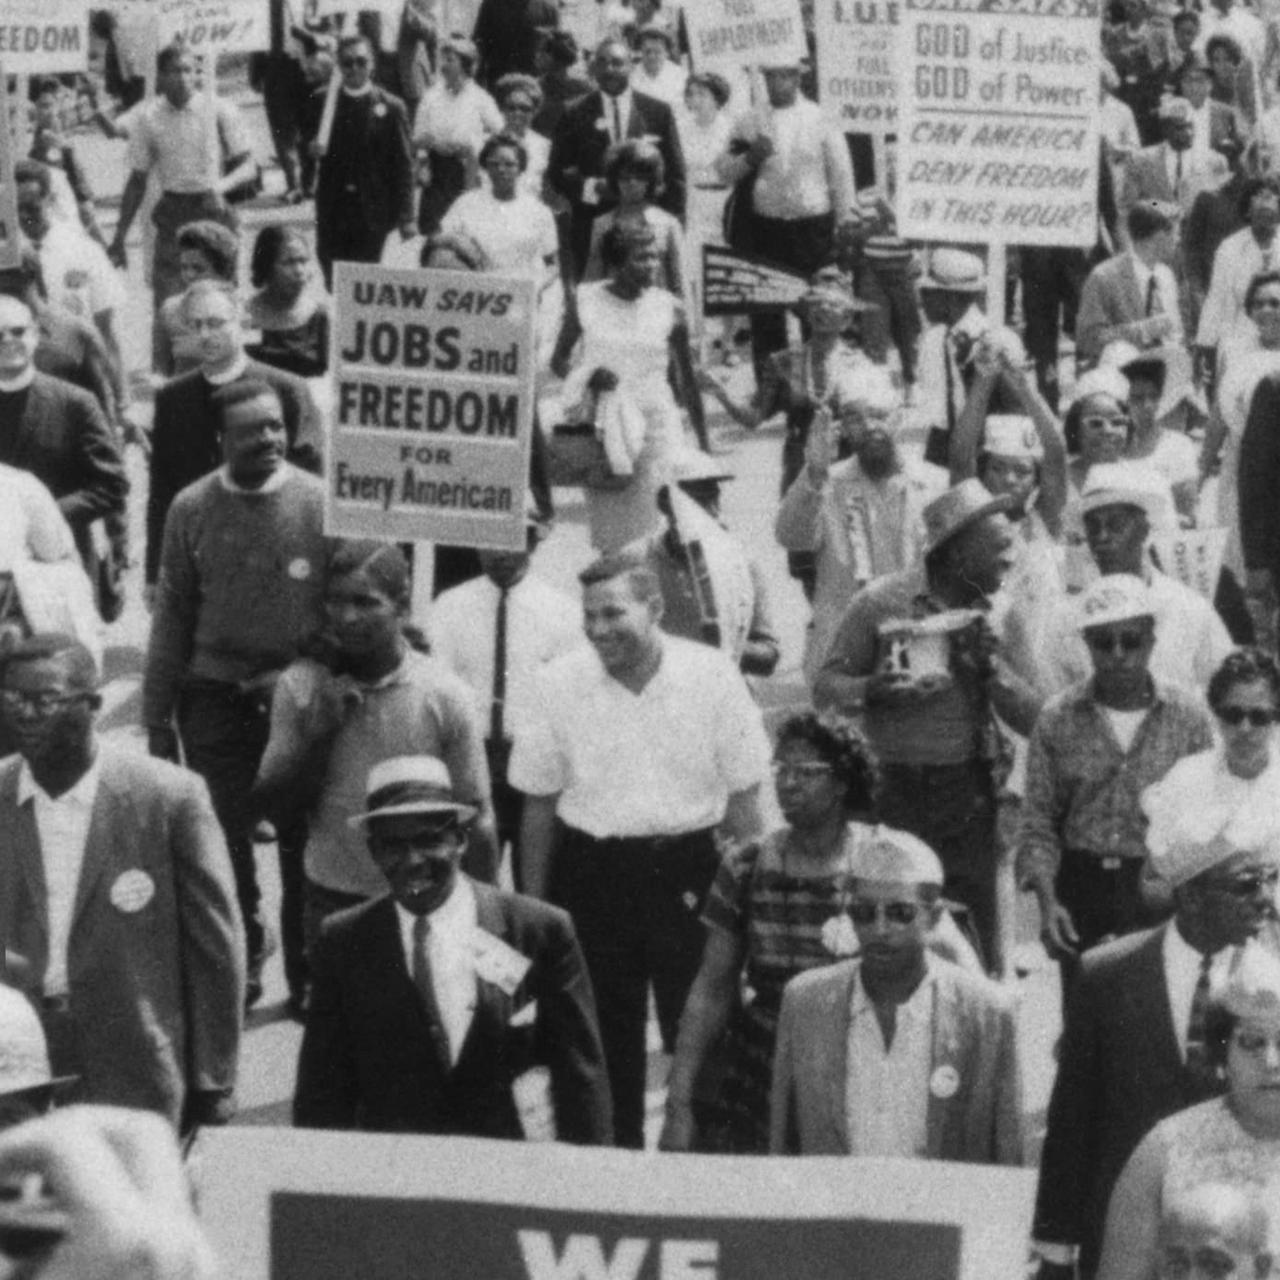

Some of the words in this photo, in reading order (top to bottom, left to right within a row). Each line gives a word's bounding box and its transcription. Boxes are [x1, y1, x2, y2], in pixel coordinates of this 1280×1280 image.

[0, 24, 81, 53] EEDOM
[915, 22, 970, 59] GOD
[979, 26, 1007, 61] of
[915, 64, 970, 100] GOD
[979, 71, 1007, 102] of
[1015, 72, 1087, 107] Power
[910, 121, 968, 145] CAN
[971, 124, 1087, 151] AMERICA
[908, 160, 975, 186] DENY
[975, 161, 1090, 190] FREEDOM
[944, 198, 997, 225] THIS
[353, 281, 428, 310] UAW
[436, 287, 513, 318] SAYS
[341, 319, 462, 371] JOBS
[467, 342, 520, 376] and
[338, 381, 520, 439] FREEDOM
[399, 445, 453, 465] FOR
[335, 461, 396, 512] Every
[401, 466, 512, 511] American
